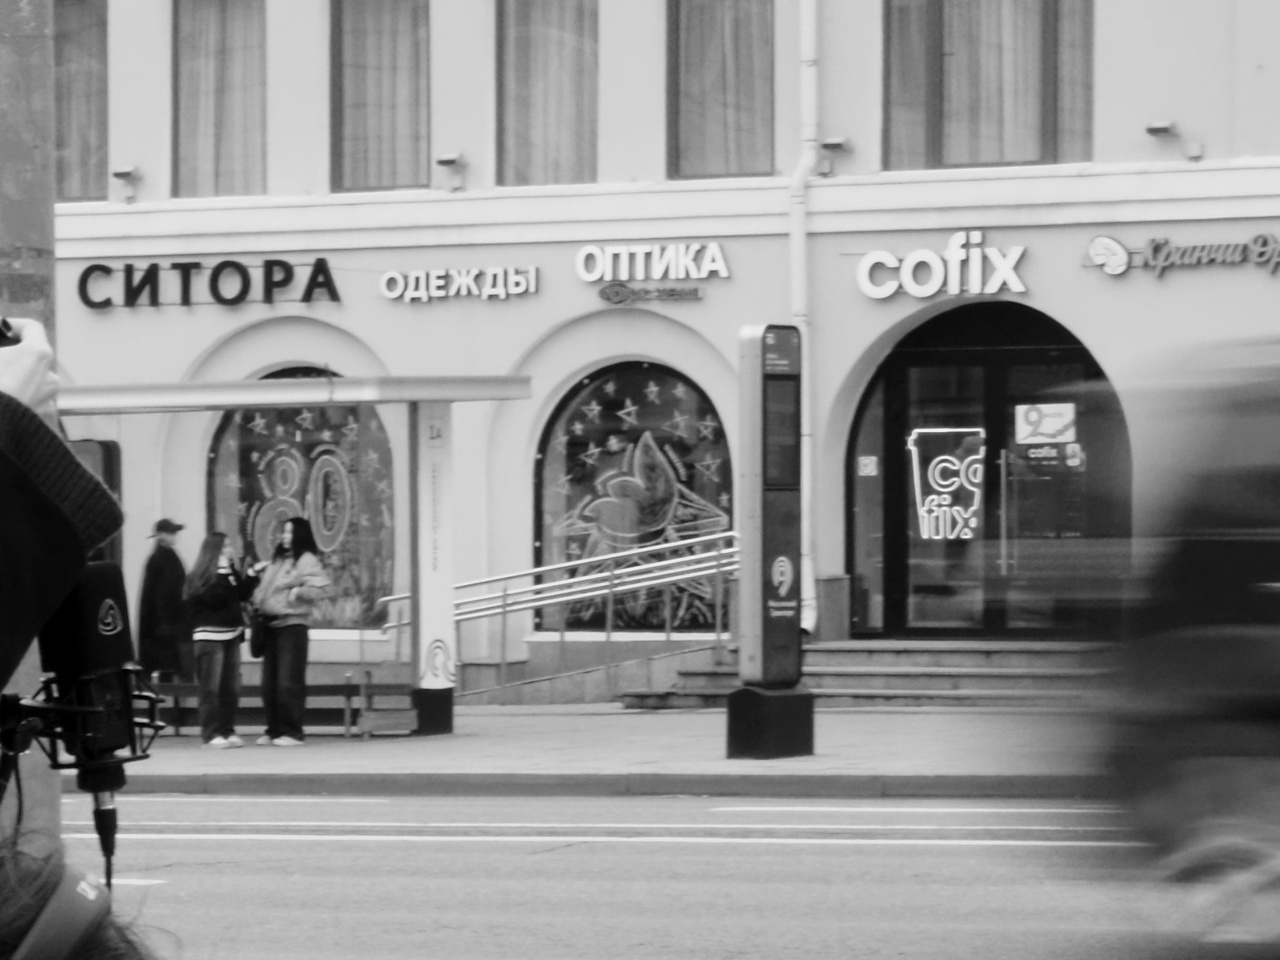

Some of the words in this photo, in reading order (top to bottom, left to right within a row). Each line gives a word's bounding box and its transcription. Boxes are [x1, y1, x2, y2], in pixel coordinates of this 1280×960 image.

[78, 258, 340, 308] СИТОРА
[576, 242, 729, 281] ОПТИКА
[857, 231, 1027, 298] cofix
[381, 267, 537, 301] ОДЕЖДЫ
